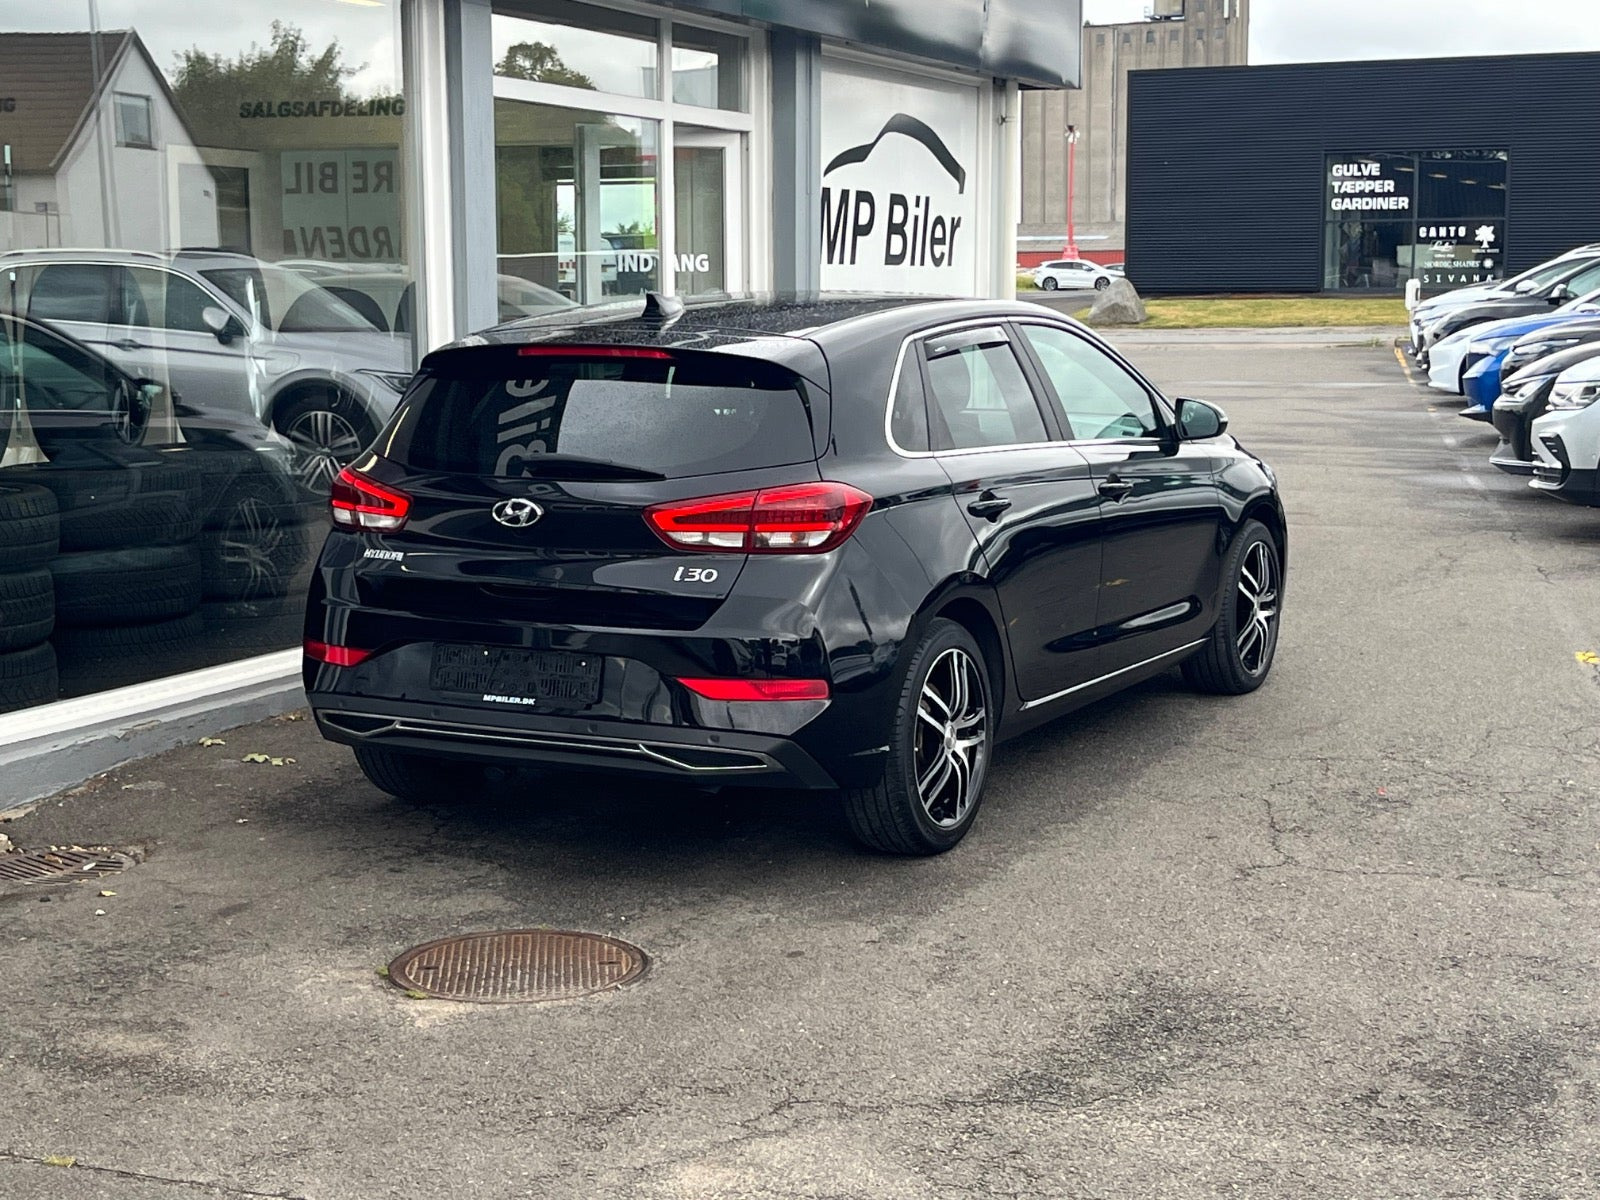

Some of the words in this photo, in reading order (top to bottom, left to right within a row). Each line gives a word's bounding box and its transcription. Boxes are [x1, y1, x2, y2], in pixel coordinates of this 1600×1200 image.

[239, 99, 405, 118] SALGSAFDELING
[1332, 163, 1381, 177] GULVE
[1332, 180, 1395, 193] TÆPPER
[1331, 197, 1409, 210] GARDINER
[820, 187, 876, 265] MP
[884, 193, 961, 267] Biler
[1419, 225, 1466, 238] CANTO
[1423, 273, 1493, 283] SIVANA
[483, 694, 536, 706] MPBILER.DK
